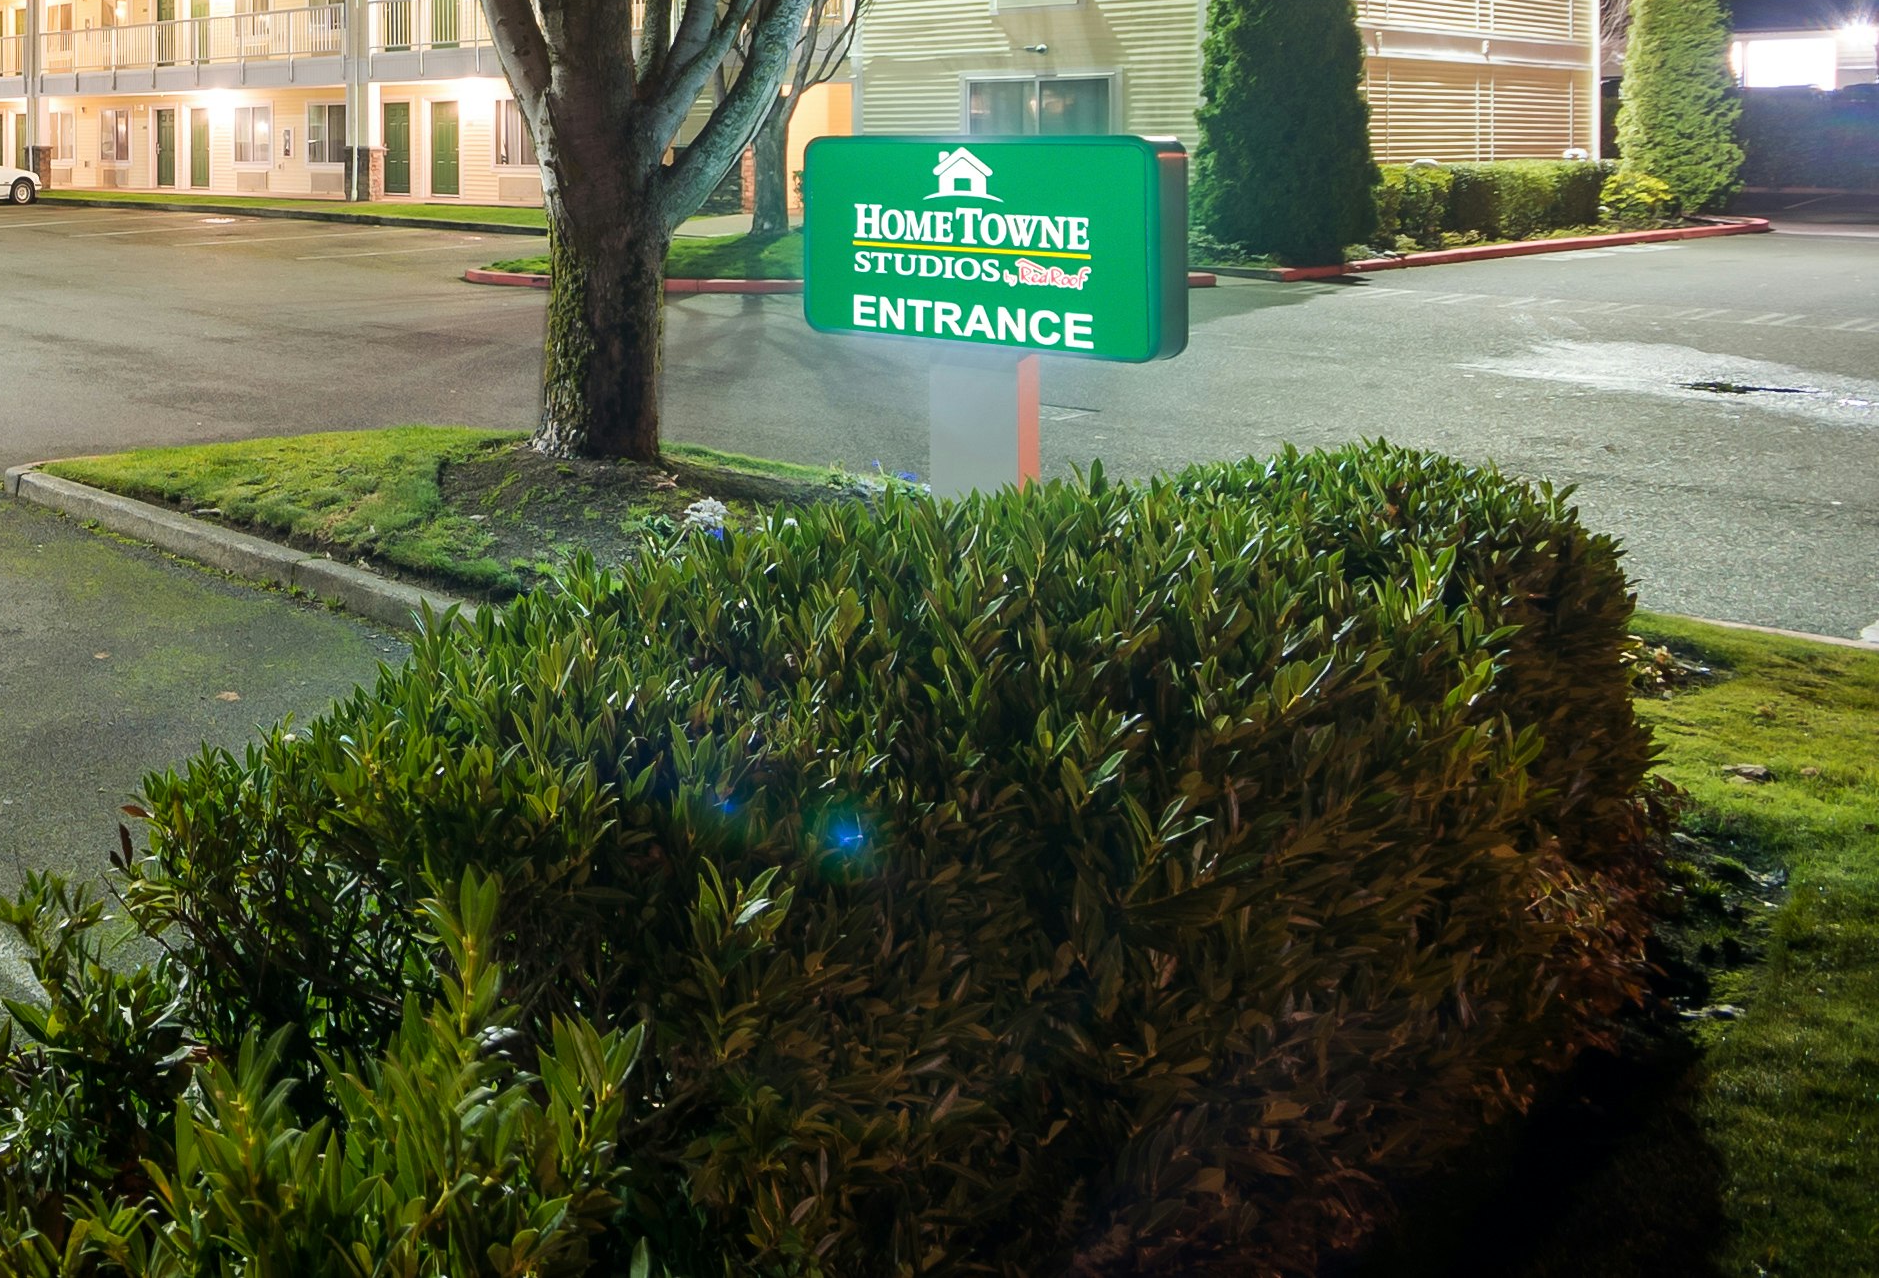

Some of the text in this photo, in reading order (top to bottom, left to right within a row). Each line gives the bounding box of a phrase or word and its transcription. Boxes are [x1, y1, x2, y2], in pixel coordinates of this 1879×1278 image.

[853, 251, 1001, 282] STUDIOS
[1003, 269, 1018, 287] by
[852, 294, 1094, 349] ENTRANCE
